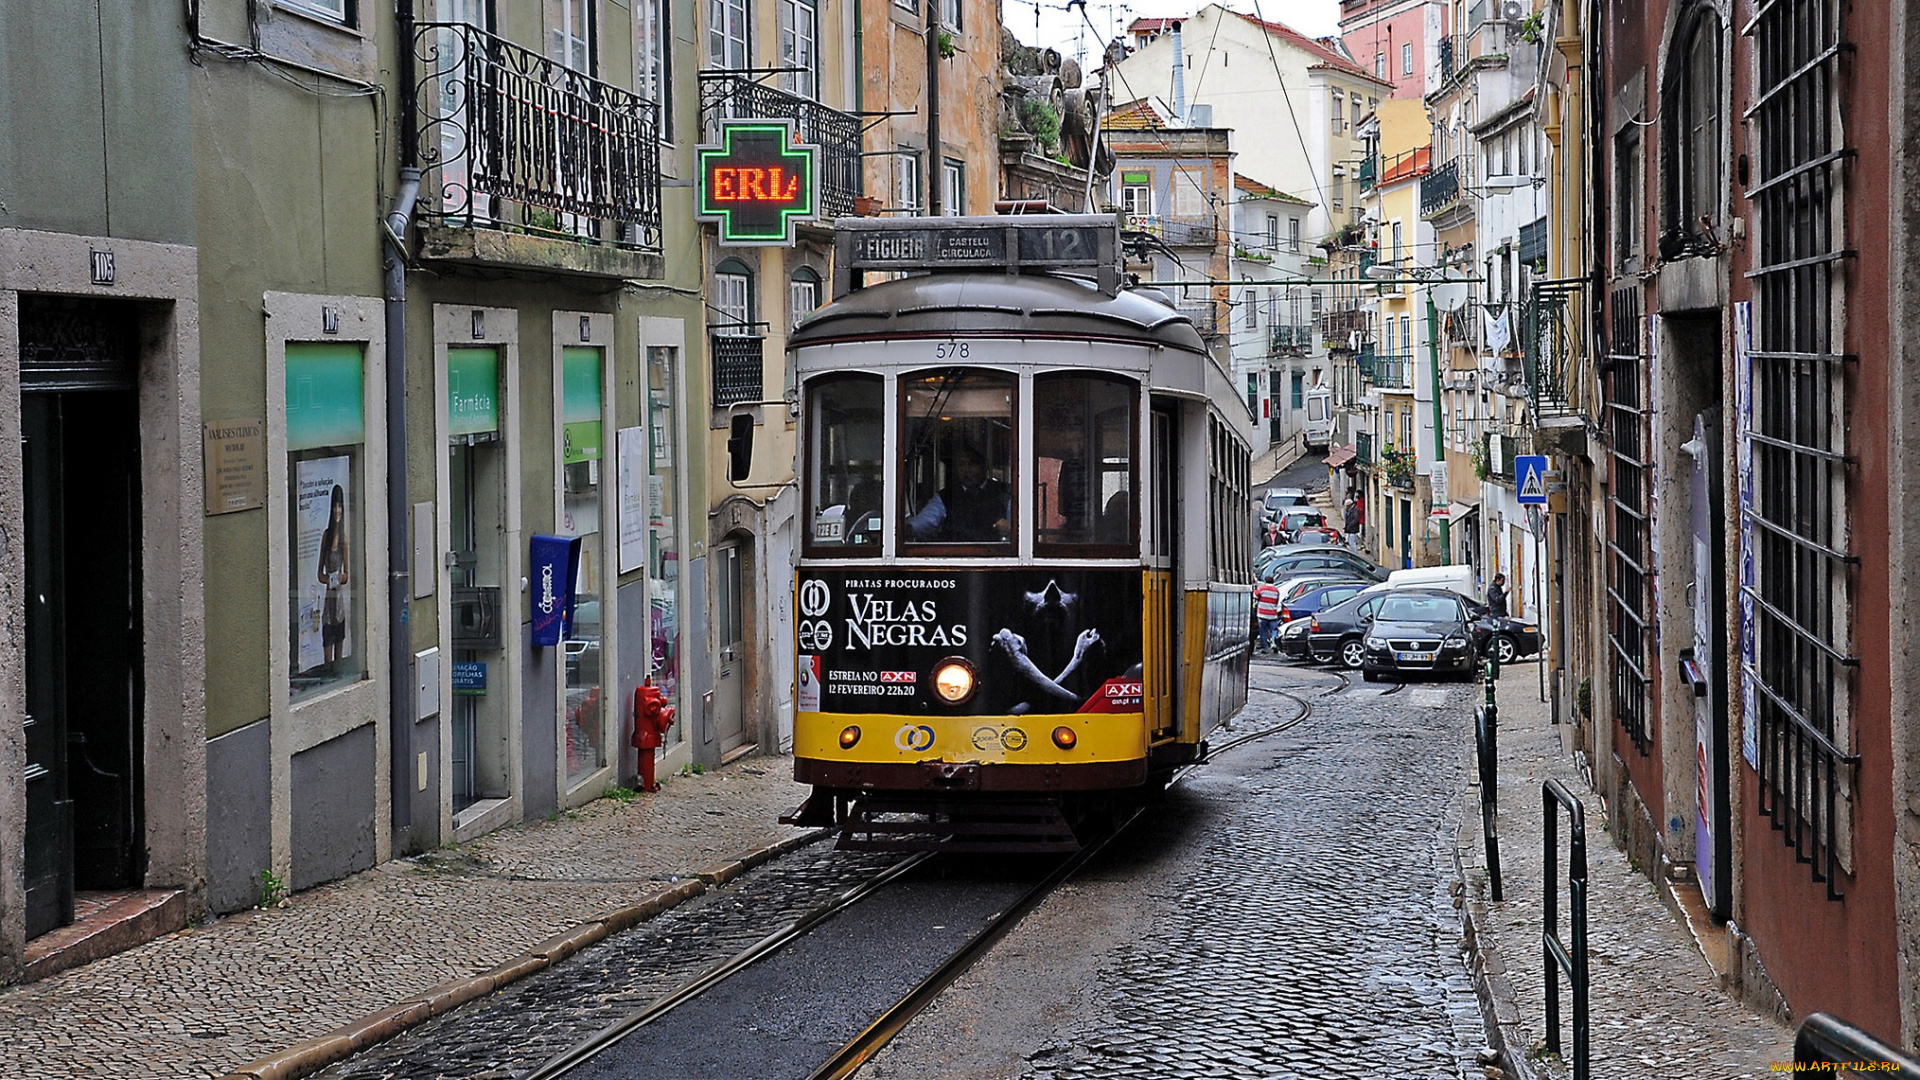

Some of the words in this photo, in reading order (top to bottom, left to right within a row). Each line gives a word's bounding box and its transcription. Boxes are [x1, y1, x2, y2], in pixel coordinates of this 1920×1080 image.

[1042, 229, 1080, 259] 12
[94, 253, 114, 280] 105
[936, 342, 969, 359] 578
[454, 393, 490, 412] Farmácia
[845, 580, 882, 588] PIRATAS
[885, 580, 956, 588] PROCURADOS
[847, 593, 937, 625] VELAS
[845, 619, 967, 650] NEGRAS
[829, 670, 861, 681] ESTREIA
[862, 671, 878, 681] NO
[882, 671, 915, 682] AXN
[829, 684, 837, 694] 12
[837, 684, 885, 695] FEVEREIRO
[886, 686, 915, 696] 22h20
[1107, 684, 1141, 696] AXN
